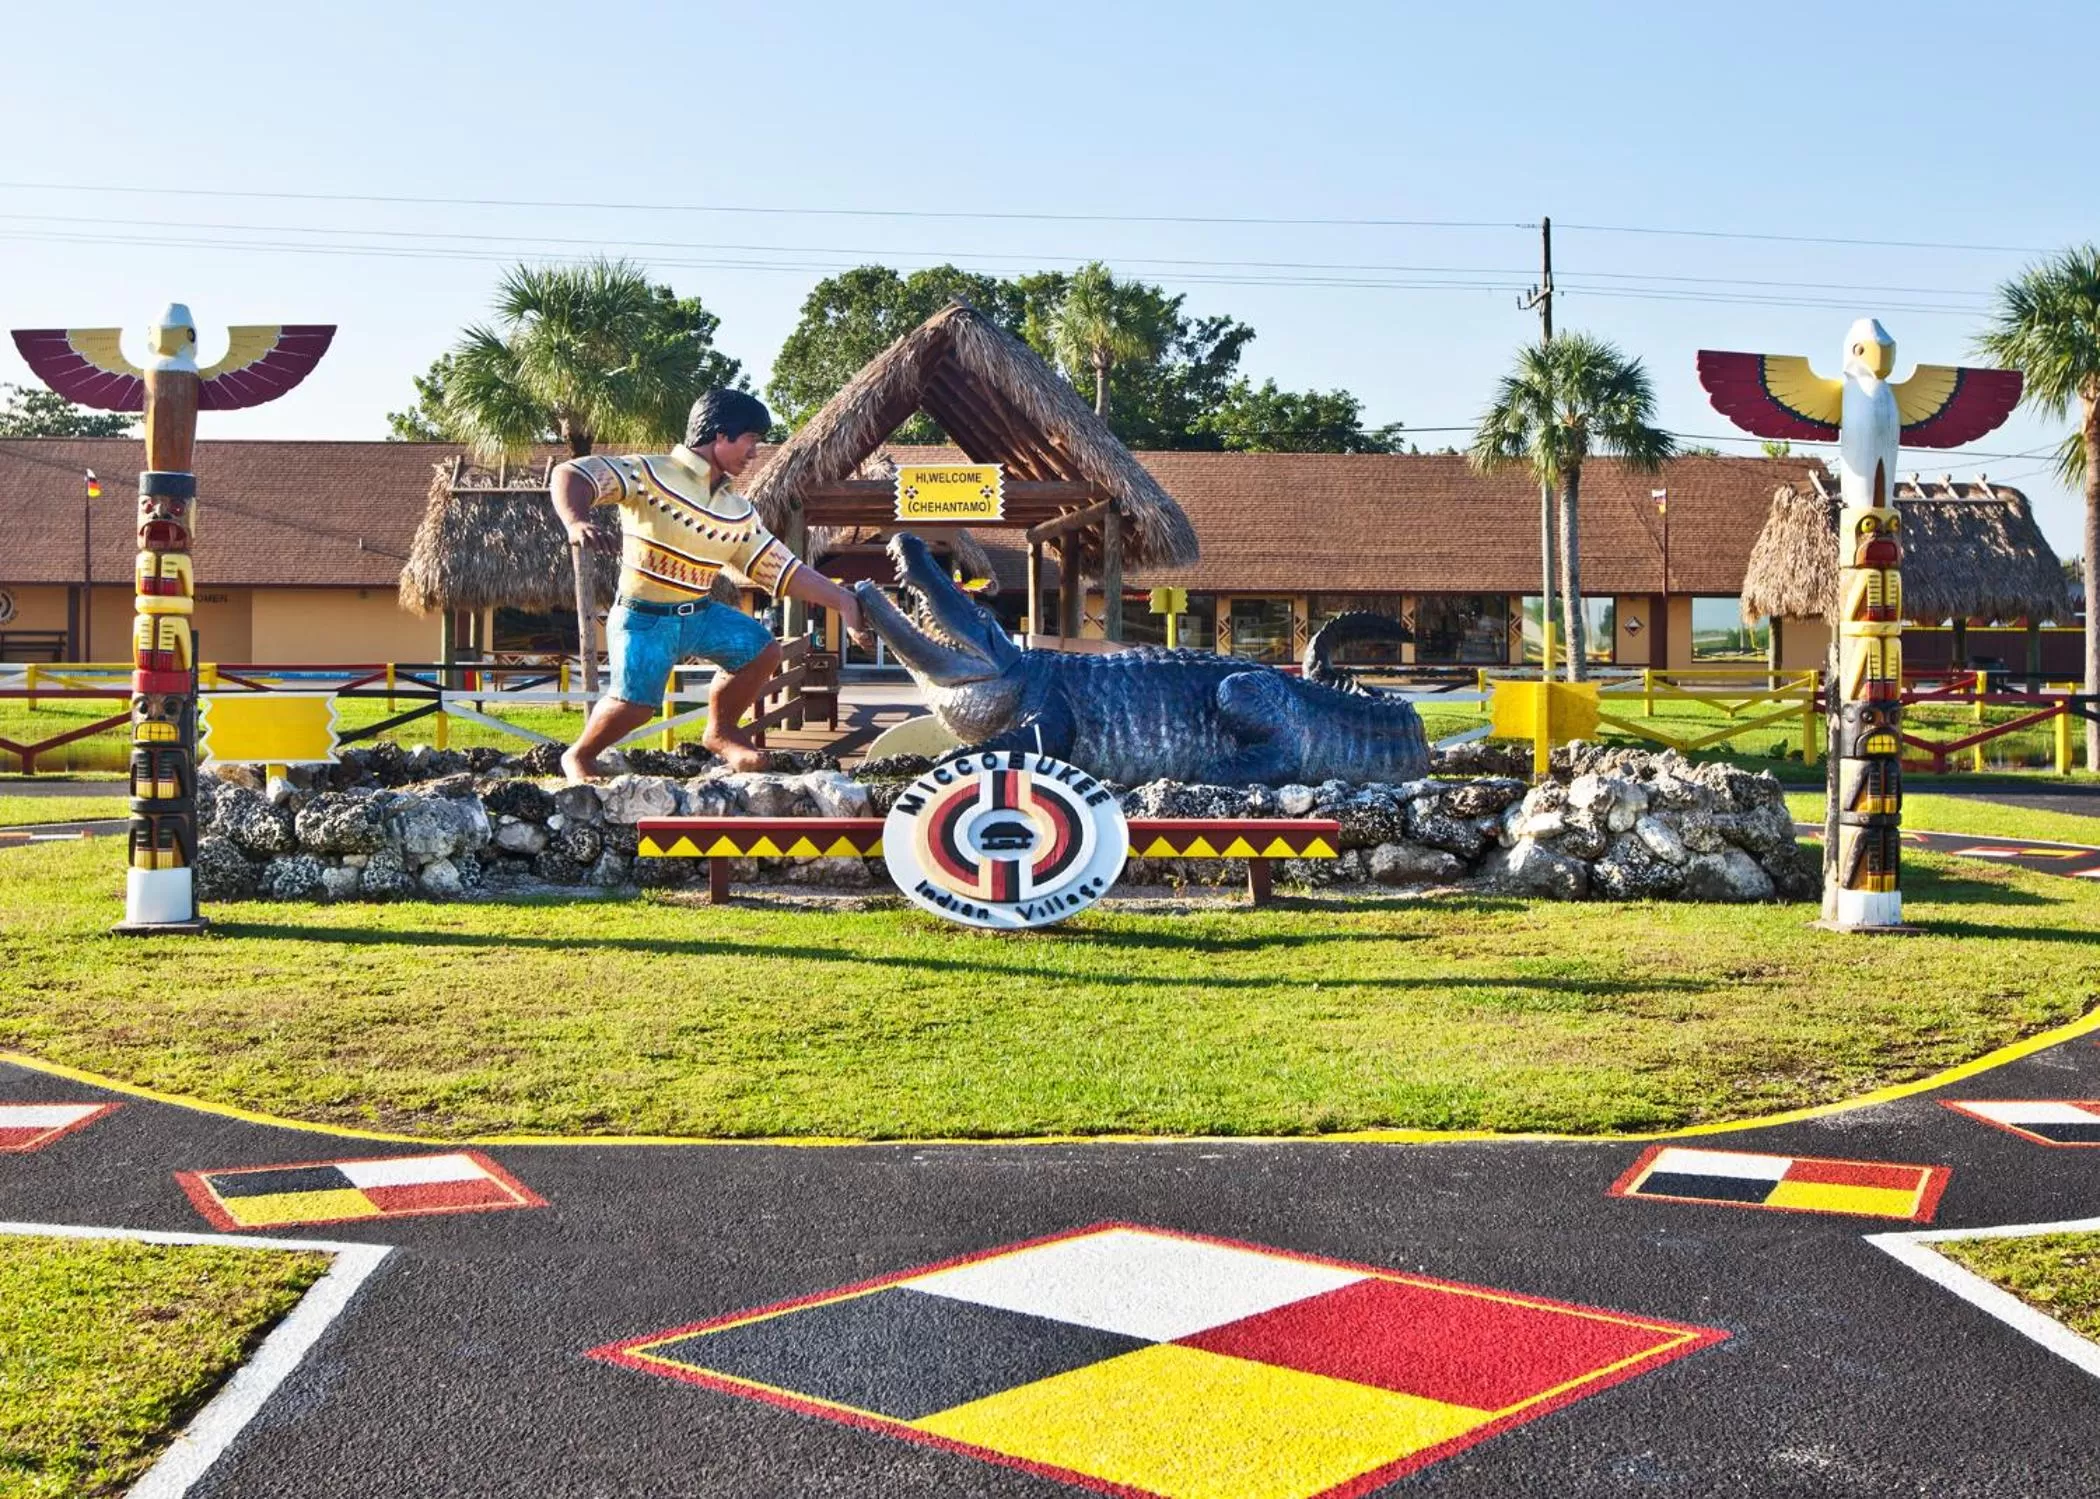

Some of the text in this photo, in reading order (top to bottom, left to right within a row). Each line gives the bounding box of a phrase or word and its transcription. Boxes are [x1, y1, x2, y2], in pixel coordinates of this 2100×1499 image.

[916, 473, 982, 484] HI,WELCOME
[908, 501, 991, 512] (CHEHANTAMO)
[915, 877, 1104, 921] Indian Village
